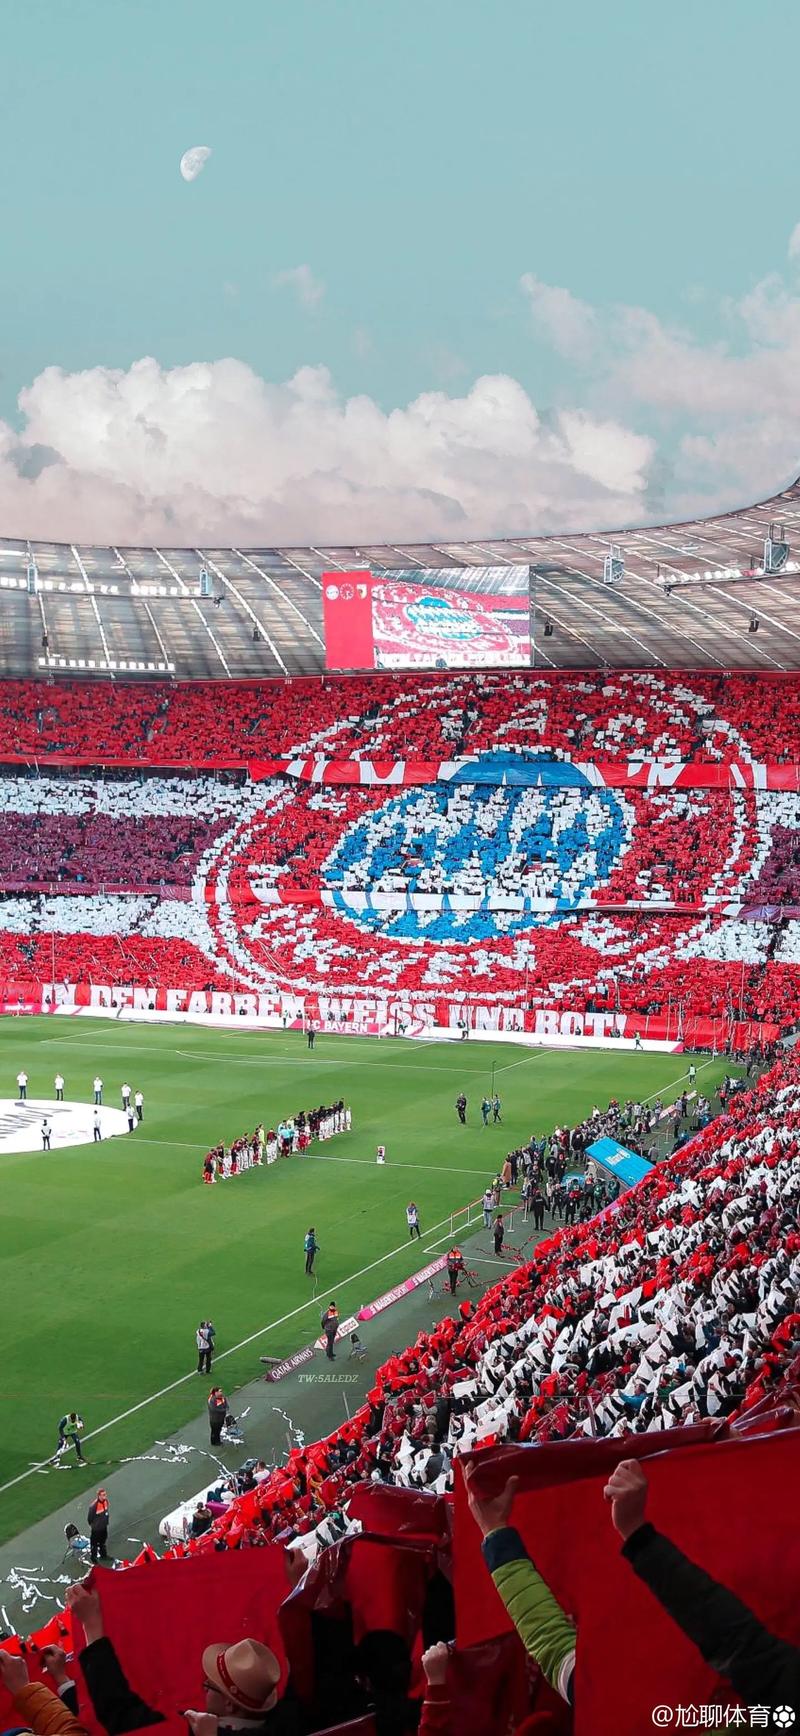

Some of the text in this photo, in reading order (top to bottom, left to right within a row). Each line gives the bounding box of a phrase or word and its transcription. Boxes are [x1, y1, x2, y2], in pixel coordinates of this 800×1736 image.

[42, 983, 628, 1038] IN DEN FARBEN WEISS UND ROT!
[324, 1021, 368, 1034] BAYERN
[270, 1347, 313, 1380] QATAR AIRWAYS
